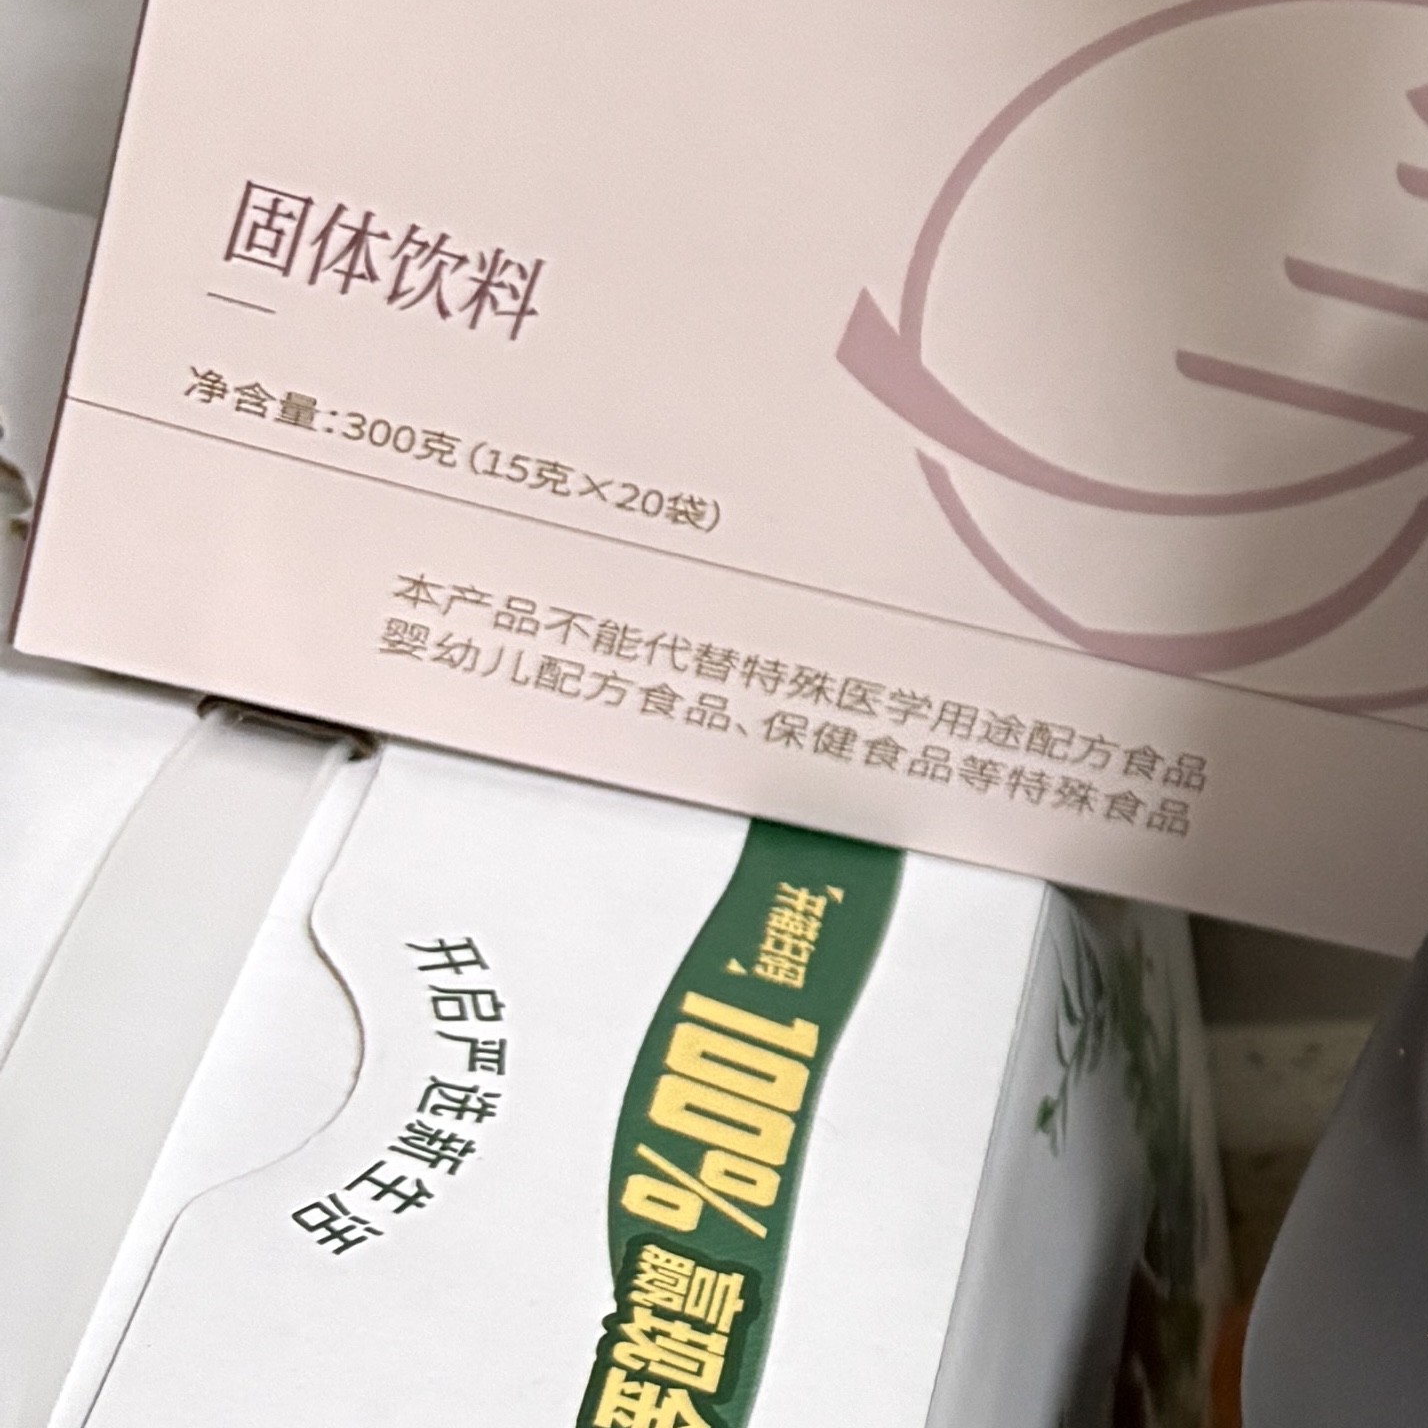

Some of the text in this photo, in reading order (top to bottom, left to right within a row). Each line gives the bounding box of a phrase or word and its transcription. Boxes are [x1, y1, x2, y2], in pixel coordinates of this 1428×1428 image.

[224, 180, 547, 342] 固体饮料
[376, 616, 1193, 838] 婴幼儿配方食品、保健食品等特殊食品
[393, 572, 1210, 793] 本产品不能代替特殊医学用途配方食品
[291, 935, 510, 1256] 开启严选新生活
